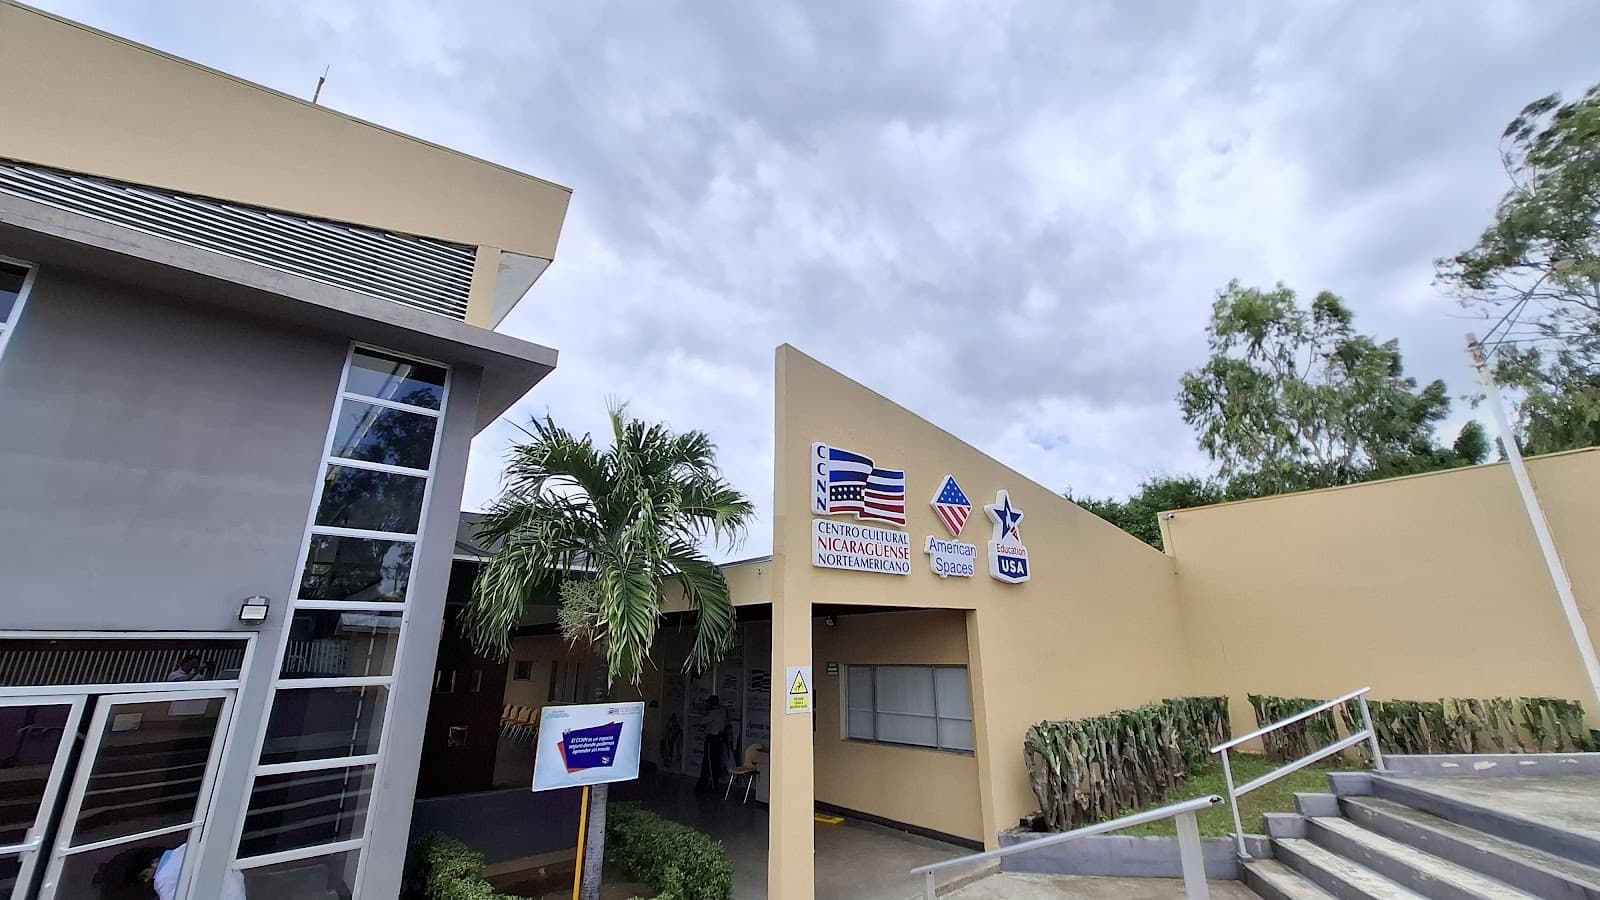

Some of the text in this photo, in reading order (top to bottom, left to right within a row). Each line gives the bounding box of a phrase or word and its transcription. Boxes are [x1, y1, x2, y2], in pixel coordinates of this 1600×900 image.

[816, 445, 827, 512] CCNN
[818, 521, 908, 545] CENTRO CULTURAL
[818, 536, 909, 560] NICARAGÜENSE
[929, 538, 977, 556] American
[996, 543, 1026, 555] Education
[818, 552, 910, 573] NORTEAMERICANO
[935, 557, 974, 576] Spaces
[1001, 559, 1025, 575] USA
